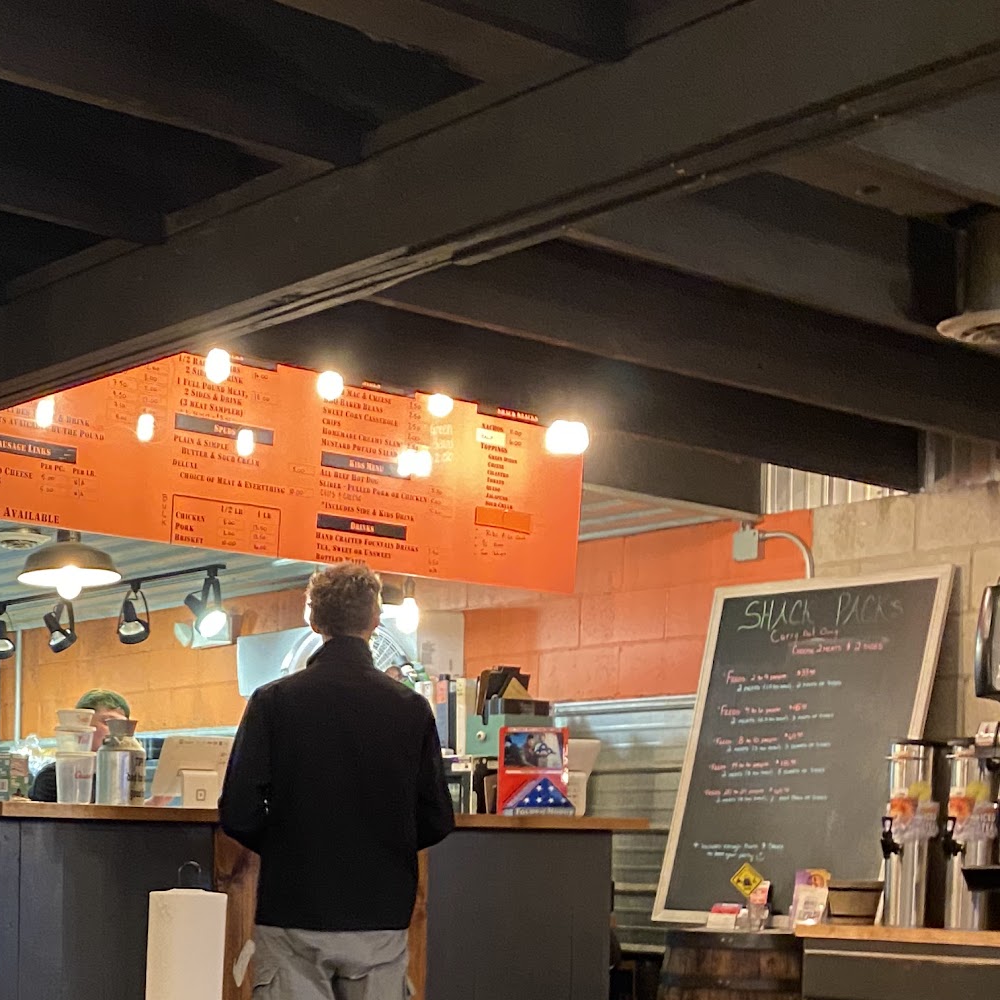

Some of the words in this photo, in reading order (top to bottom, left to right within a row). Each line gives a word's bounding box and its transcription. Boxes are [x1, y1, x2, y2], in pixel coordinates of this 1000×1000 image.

[183, 377, 201, 389] FULL
[202, 381, 226, 394] POUND
[190, 388, 211, 400] SIDES
[220, 394, 242, 406] DRINK
[347, 389, 361, 399] MAC
[368, 393, 392, 405] CHEESE
[189, 399, 208, 410] MEAT
[209, 403, 244, 418] SAMPLER)
[340, 399, 362, 410] BAKED
[363, 402, 384, 414] BEANS
[322, 406, 344, 417] SWEET
[345, 410, 363, 421] CORN
[364, 413, 399, 427] CASSEROLE
[322, 417, 341, 427] CHIPS
[213, 424, 236, 436] SPUDS
[481, 423, 504, 433] NACHOS
[79, 429, 105, 441] POUND
[322, 427, 357, 440] HOMEMADE
[358, 433, 383, 445] CREAMY
[173, 434, 195, 445] PLAIN
[203, 440, 229, 450] SIMPLE
[321, 438, 351, 450] MUSTARD
[352, 442, 377, 454] POTATO
[480, 442, 508, 454] TOPPINGS
[28, 443, 52, 456] LINKS
[181, 446, 208, 458] BUTTER
[217, 453, 236, 463] SOUR
[237, 456, 260, 467] CREAM
[40, 462, 53, 471] PER
[172, 459, 198, 469] DELUXE
[349, 459, 365, 470] KIDS
[366, 462, 385, 473] MENU
[4, 467, 33, 480] CHEESE
[72, 467, 85, 476] PER
[321, 469, 332, 478] ALL
[334, 470, 350, 481] BEEF
[351, 472, 364, 482] HOT
[179, 471, 205, 482] CHOICE
[217, 476, 235, 487] MEAT
[244, 481, 286, 494] EVERYTHING
[319, 480, 342, 489] SLIDER
[347, 483, 371, 494] PULLED
[372, 488, 389, 497] PORK
[401, 492, 428, 504] CHICKEN
[3, 506, 60, 524] AVAILABLE
[220, 505, 233, 514] 1/2
[356, 506, 370, 516] SIDE
[379, 510, 394, 520] KIDS
[395, 512, 415, 522] DRINK
[175, 511, 206, 523] CHICKEN
[175, 522, 195, 532] PORK
[350, 521, 375, 533] DRINKS
[174, 533, 204, 545] BRISKET
[315, 531, 334, 542] HAND
[334, 534, 363, 546] CRAFTED
[364, 537, 394, 549] FOUNTAIN
[395, 542, 419, 553] DRINKS
[315, 552, 343, 563] BOTTLED
[332, 544, 352, 555] SWEET
[364, 549, 392, 560] UNSWEET
